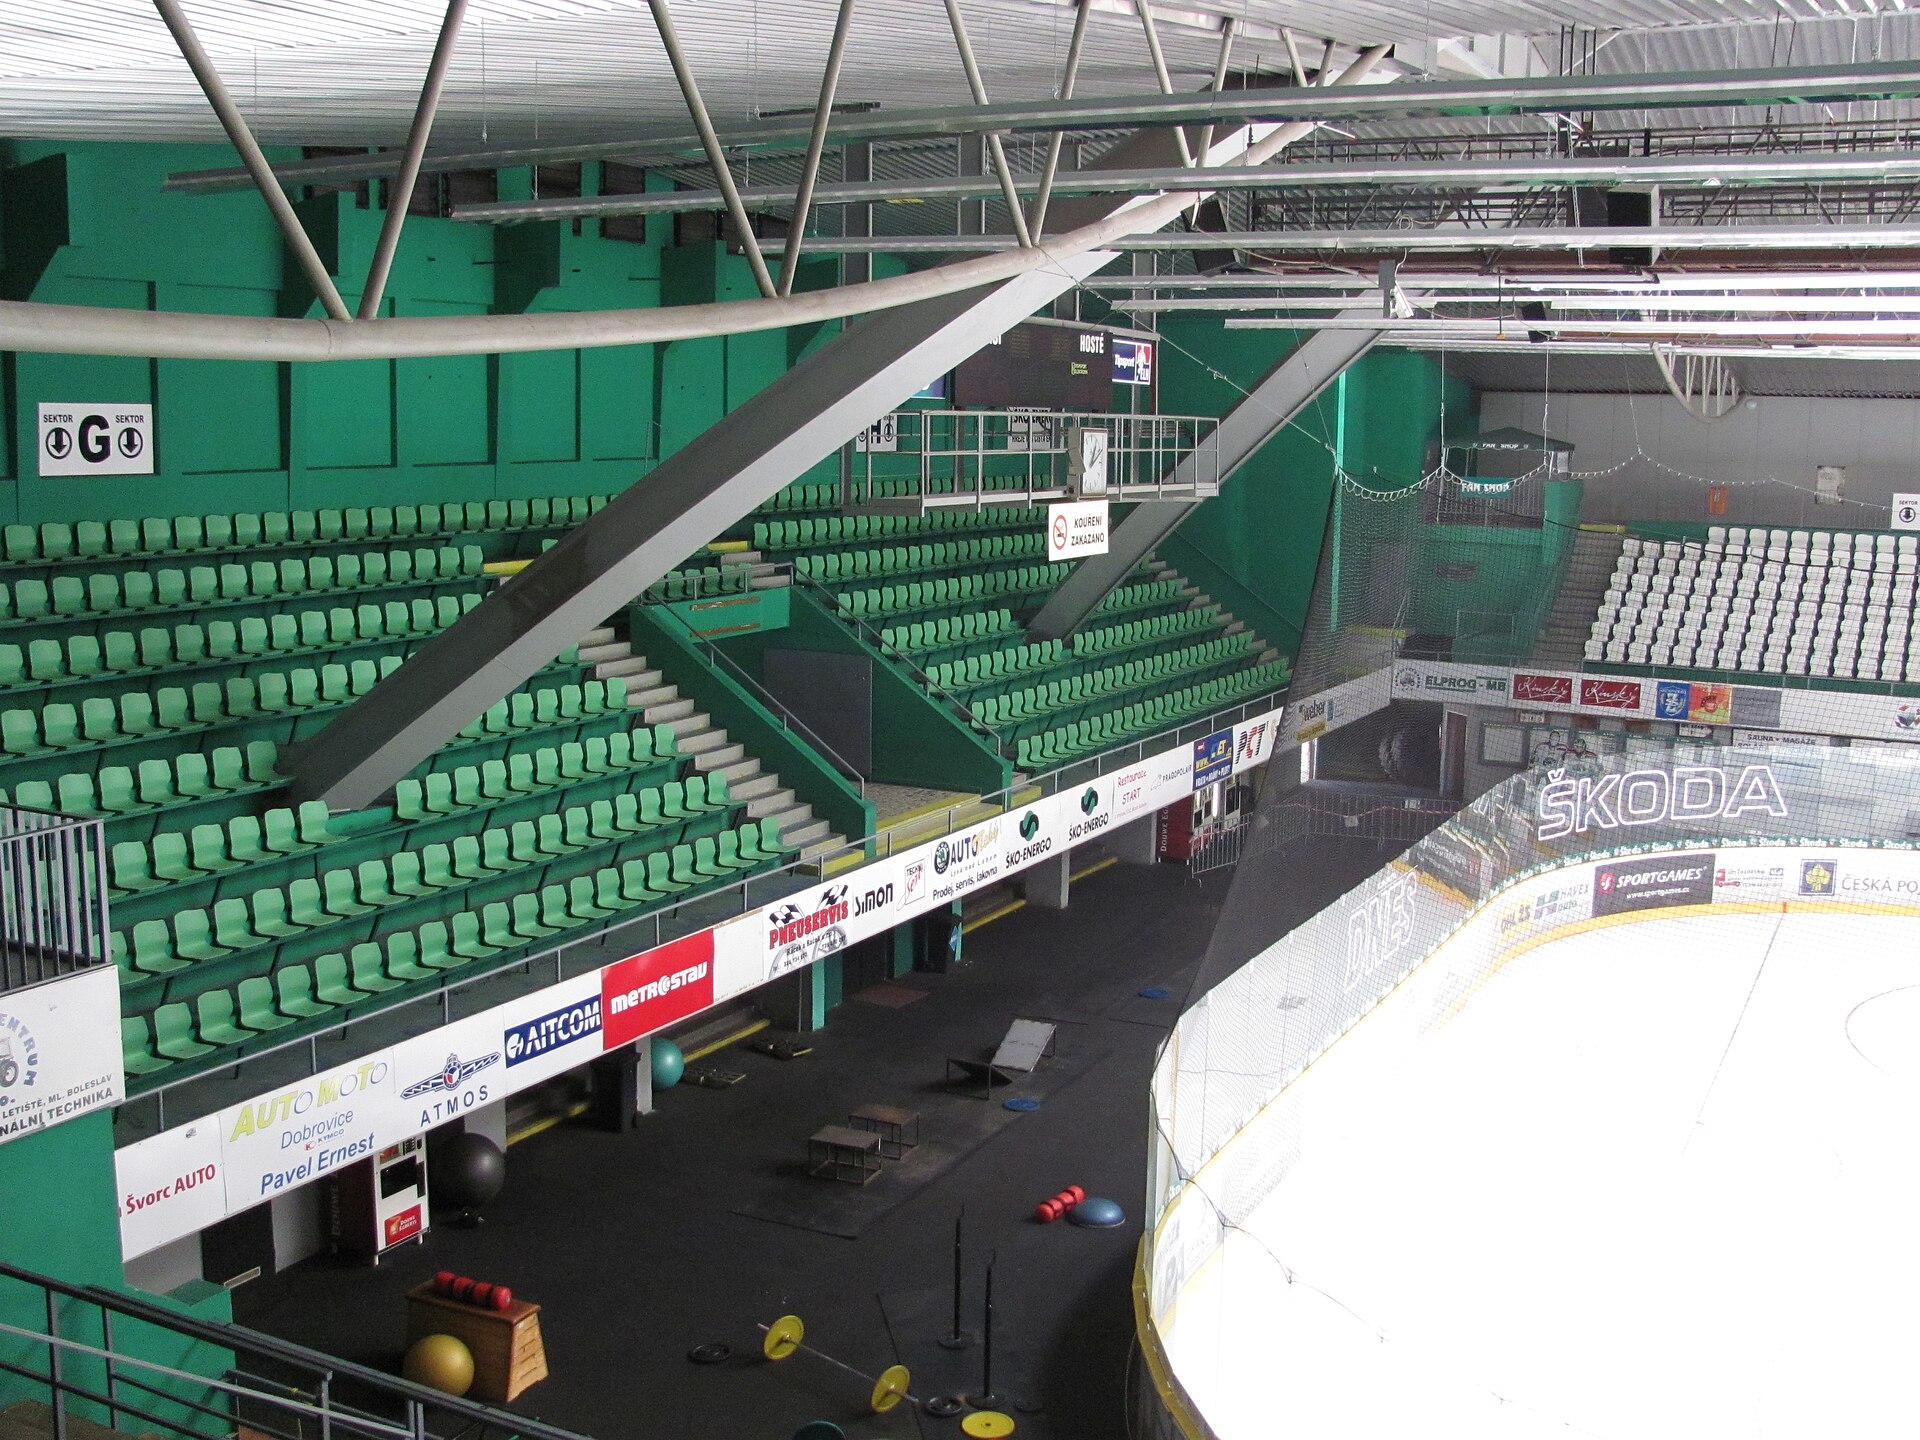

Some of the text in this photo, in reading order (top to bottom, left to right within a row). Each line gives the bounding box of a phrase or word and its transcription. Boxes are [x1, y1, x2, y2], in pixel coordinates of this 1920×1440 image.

[1080, 333, 1104, 353] HOSTÉ
[1115, 354, 1134, 368] Tipsport
[43, 414, 73, 423] SEKTOR
[115, 414, 144, 423] SEKTOR
[78, 414, 111, 463] G
[1461, 483, 1510, 492] FAN SHOP
[1074, 512, 1102, 529] KOUŘENÍ
[1425, 674, 1477, 690] ELPROG
[1486, 680, 1506, 692] MB
[1122, 788, 1141, 805] START
[1537, 765, 1788, 841] ŠKODA
[1069, 812, 1109, 841] ŠKO-ENERGO
[951, 834, 978, 866] AUTO
[1006, 837, 1051, 869] ŠKO-ENERGO
[932, 884, 954, 900] Prodej,
[955, 875, 975, 891] servis,
[1616, 867, 1702, 888] SPORTGAMES
[1841, 873, 1920, 896] ČESKÁ PO
[1627, 887, 1690, 900] www.sportgames.cz
[769, 900, 849, 950] PNEUSERVIS
[525, 1000, 602, 1056] AITCOM
[2, 1073, 113, 1119] LETIŠTĚ, ML. BOLESLAV
[47, 1087, 113, 1119] TECHNIKA
[229, 1090, 313, 1143] AUTO
[317, 1062, 388, 1108] MOTO
[421, 1084, 488, 1128] ATMOS
[281, 1110, 354, 1150] Dobrovice
[318, 1128, 344, 1143] KYMCO
[261, 1131, 375, 1195] Pavel Ernest
[126, 1185, 171, 1215] Švorc
[174, 1163, 216, 1195] AUTO
